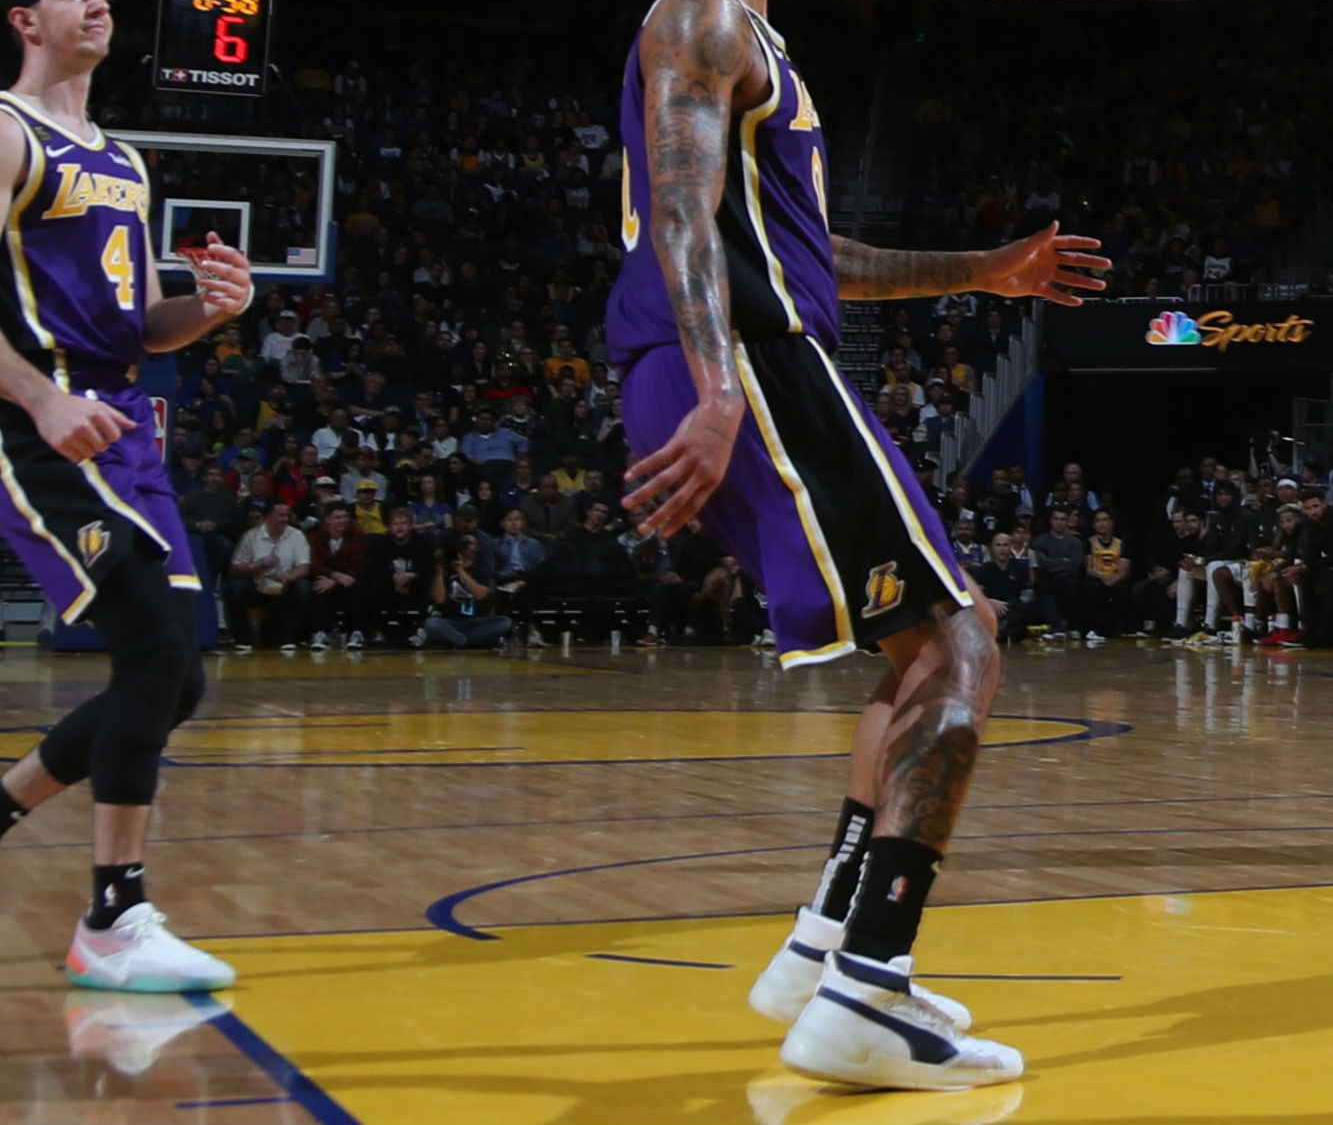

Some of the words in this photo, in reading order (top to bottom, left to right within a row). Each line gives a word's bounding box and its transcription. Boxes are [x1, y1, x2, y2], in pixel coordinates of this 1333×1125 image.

[213, 15, 249, 63] 6
[188, 70, 260, 87] TISSOT
[101, 225, 135, 310] 4
[1197, 310, 1315, 352] Sports
